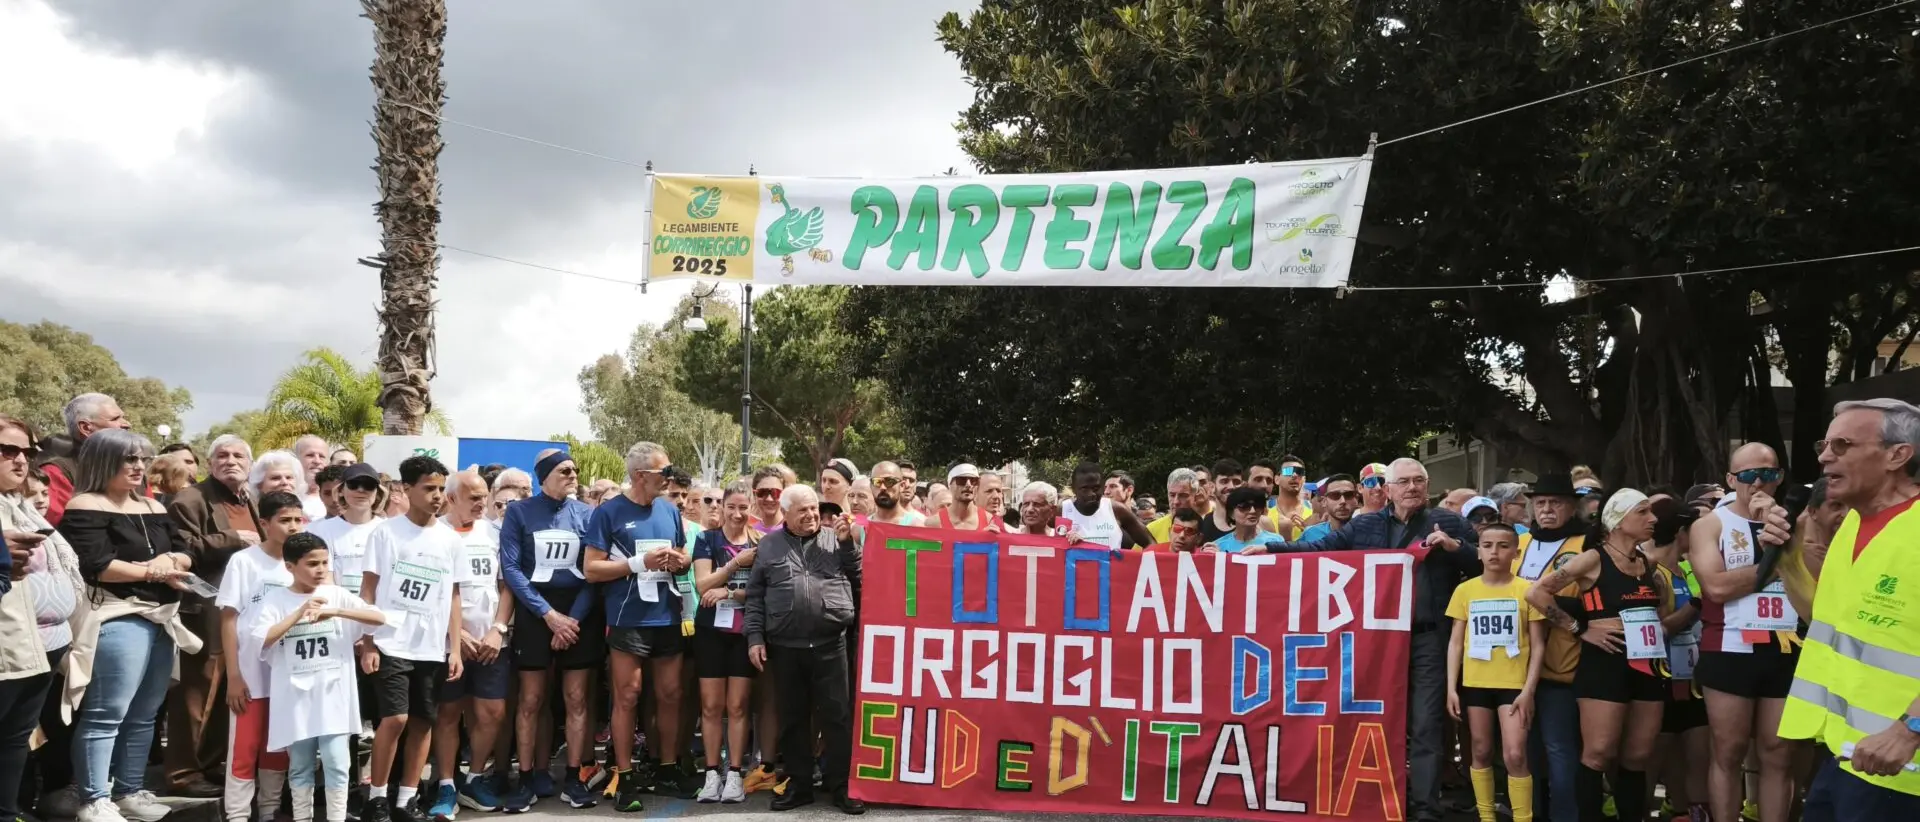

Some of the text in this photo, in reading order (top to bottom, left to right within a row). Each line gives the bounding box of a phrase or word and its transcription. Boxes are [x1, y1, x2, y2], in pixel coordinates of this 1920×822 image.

[662, 222, 739, 233] LEGAMBIENTE
[842, 177, 1256, 279] PARTENZA
[653, 234, 751, 256] CORRIREGGIO
[672, 255, 727, 276] 2025
[1096, 520, 1114, 531] wilo
[546, 542, 570, 560] 777
[1728, 554, 1750, 565] GRP
[399, 579, 430, 602] 457
[886, 538, 1415, 633] TOTO ANTIBO
[1757, 596, 1783, 618] 88
[1472, 615, 1514, 635] 1994
[1856, 610, 1902, 628] STAFF
[1640, 624, 1657, 647] 19
[295, 636, 329, 660] 473
[861, 624, 1385, 716] ORGOGLIO DEL
[857, 700, 980, 789] SUD
